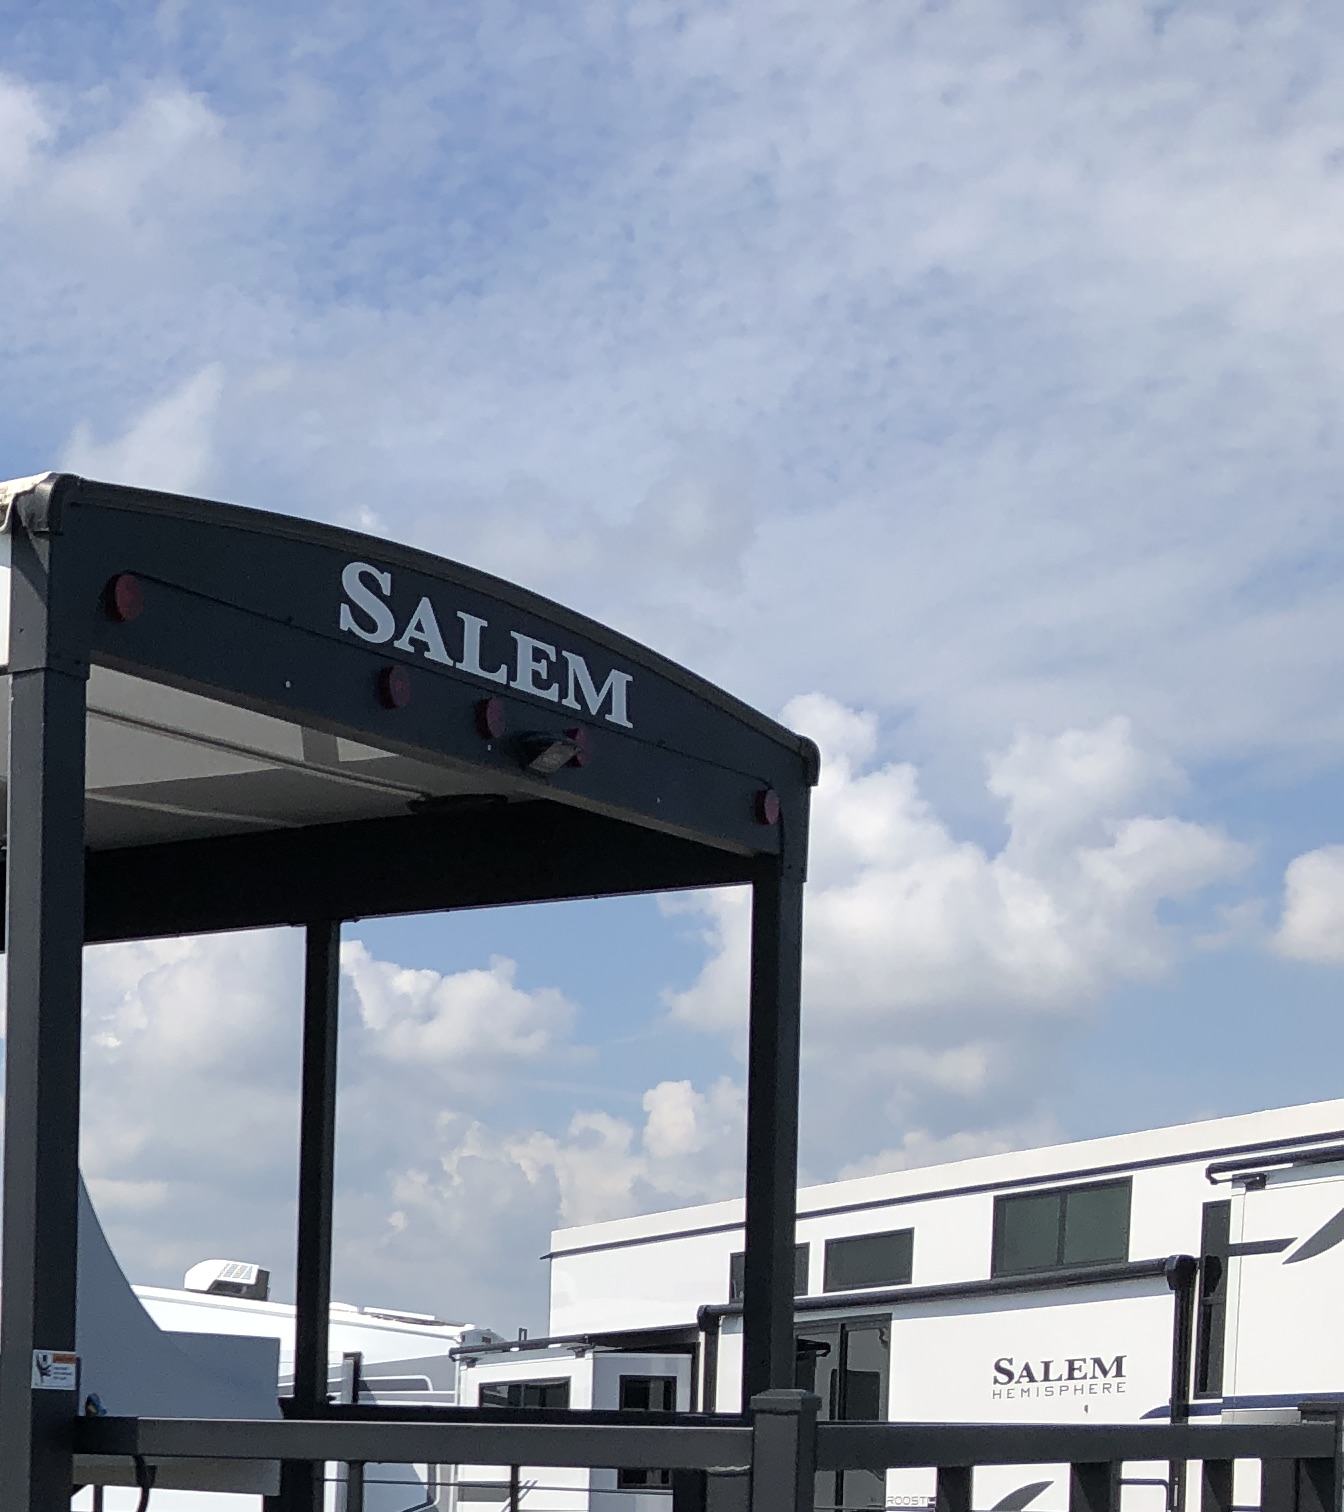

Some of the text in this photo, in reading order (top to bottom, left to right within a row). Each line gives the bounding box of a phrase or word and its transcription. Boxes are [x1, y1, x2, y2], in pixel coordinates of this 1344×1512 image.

[338, 561, 634, 729] SALEM
[992, 1355, 1127, 1385] SALEM
[992, 1381, 1127, 1399] HEMISPHERE
